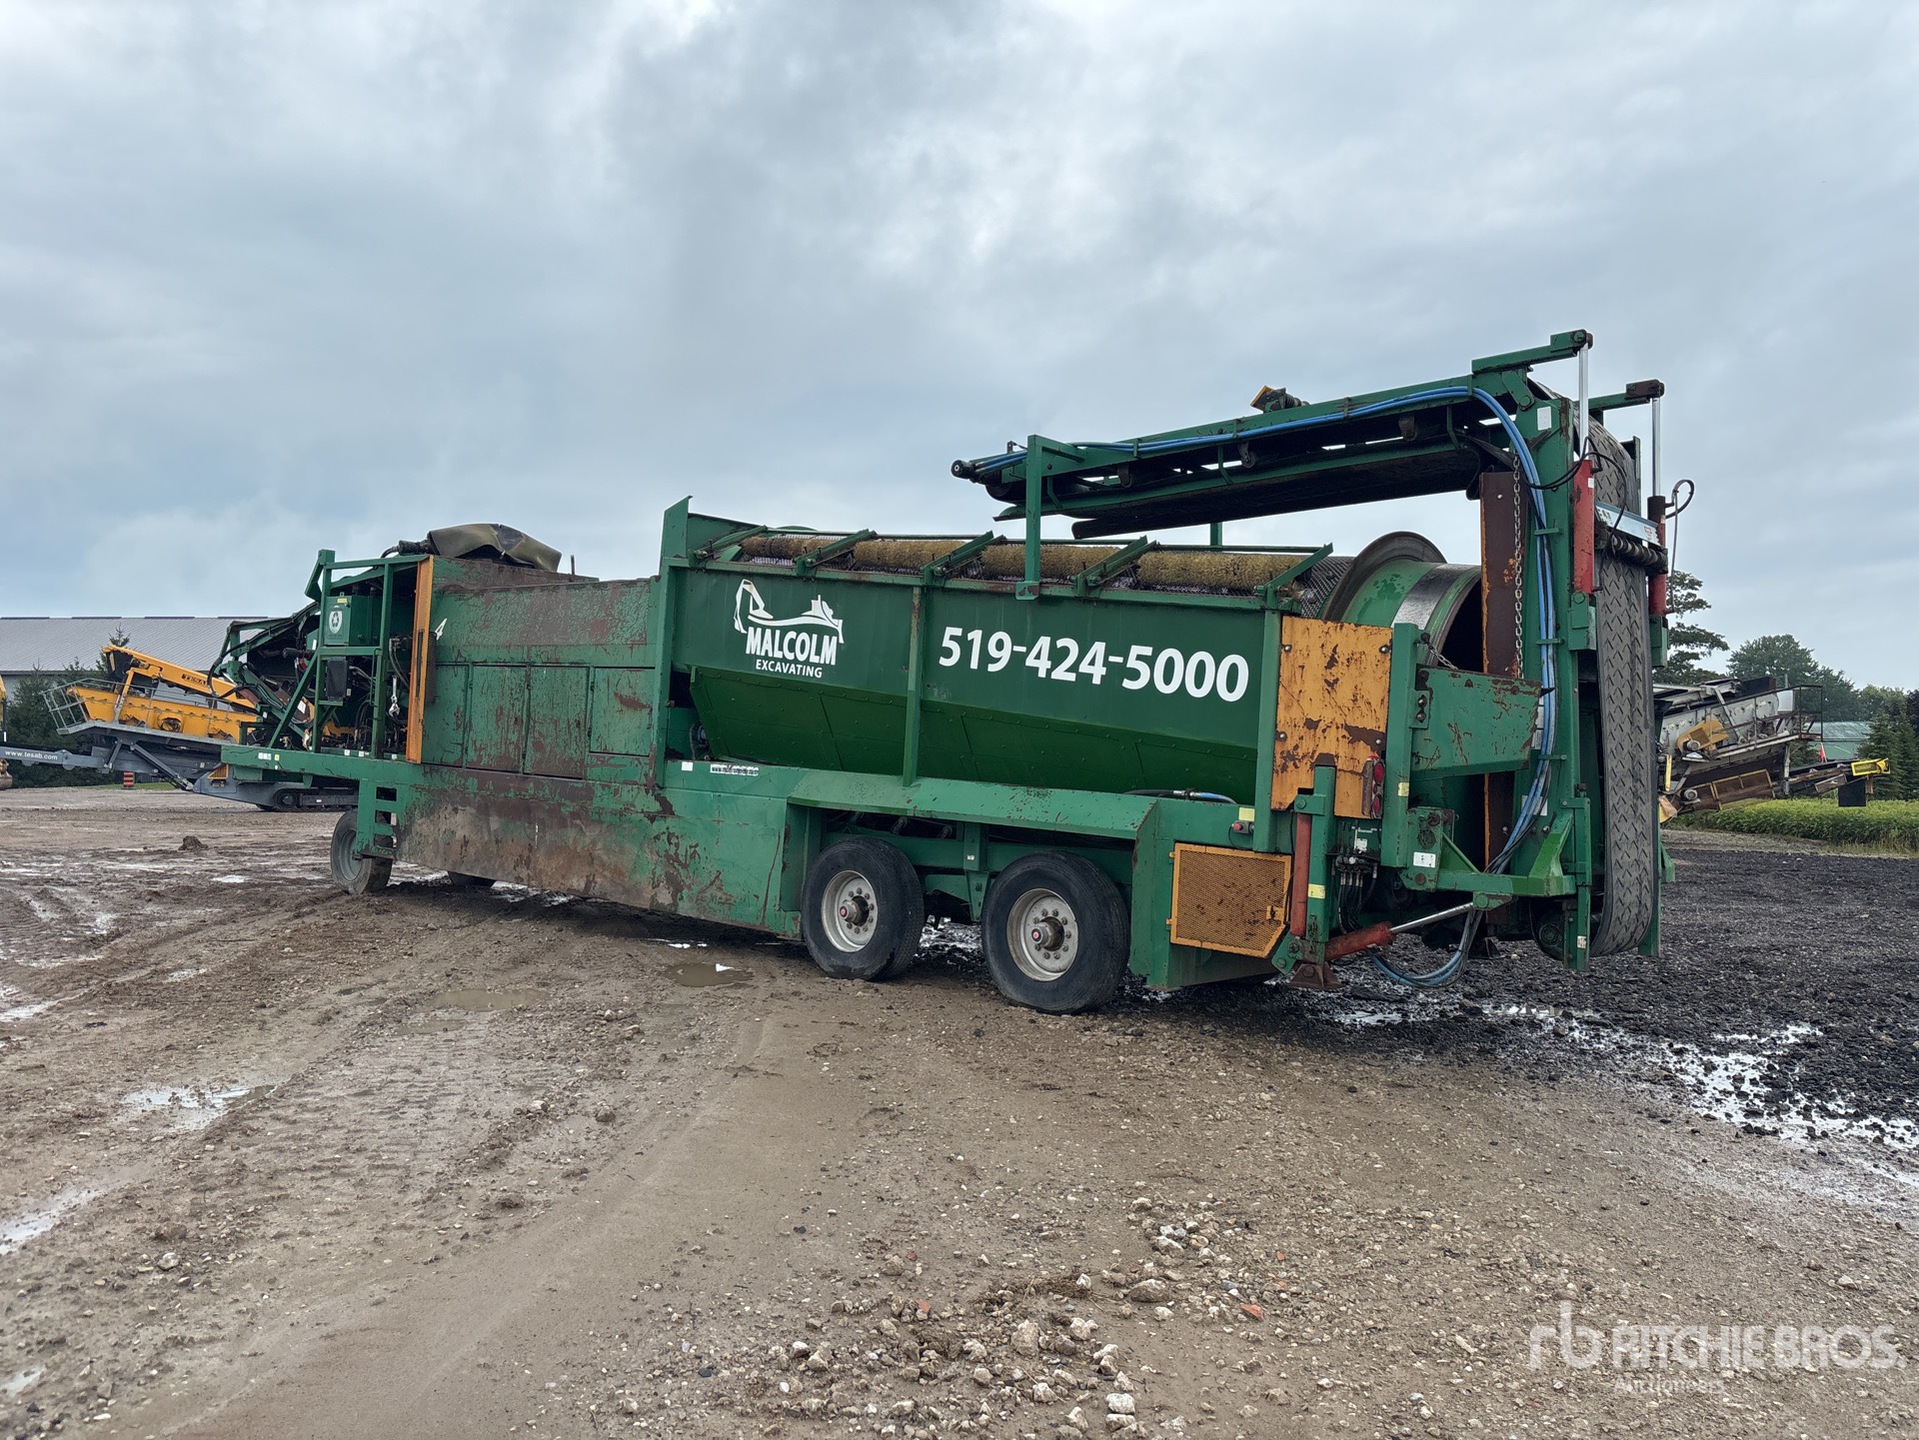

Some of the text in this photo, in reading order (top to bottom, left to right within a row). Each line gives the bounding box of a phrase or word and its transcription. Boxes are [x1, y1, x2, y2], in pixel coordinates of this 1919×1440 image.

[745, 626, 838, 666] MALCOLM
[755, 659, 823, 678] EXCAVATING
[938, 626, 1249, 702] 519-424-5000
[181, 673, 210, 687] TESA
[4, 750, 58, 761] www.tesab.com
